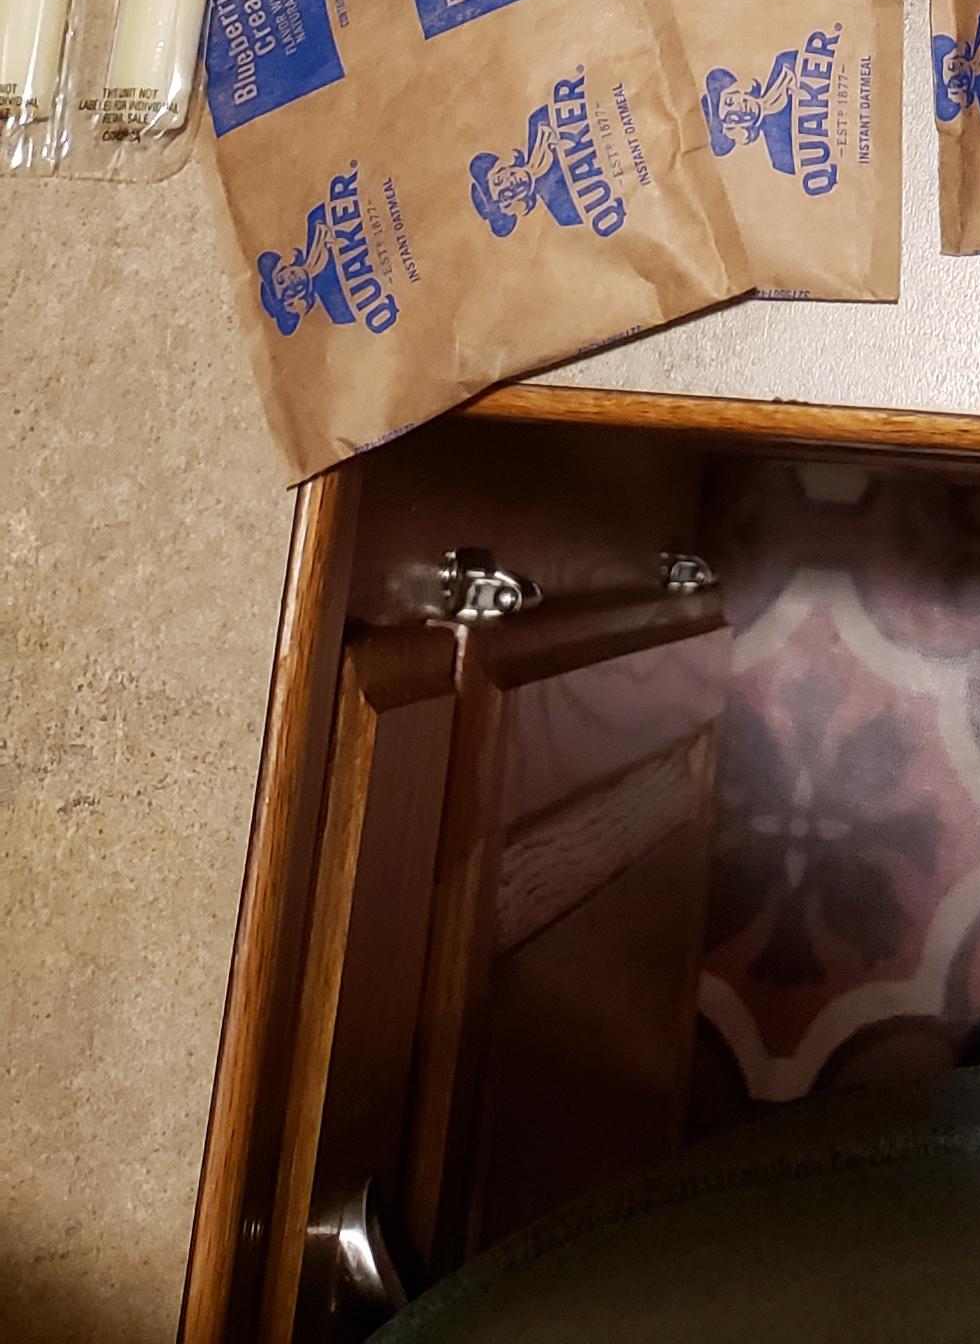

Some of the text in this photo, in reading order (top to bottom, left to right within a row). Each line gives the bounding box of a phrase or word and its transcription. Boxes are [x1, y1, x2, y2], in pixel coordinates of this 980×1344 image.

[276, 14, 297, 56] FLAVOR
[554, 75, 627, 237] QUAKER
[612, 82, 652, 186] INSTANT OATMEAL
[798, 30, 840, 196] QUAKER
[859, 56, 871, 164] INSTANT OATMEAL
[330, 170, 399, 334] QUAKER
[383, 176, 421, 283] INSTANT OATMEAL
